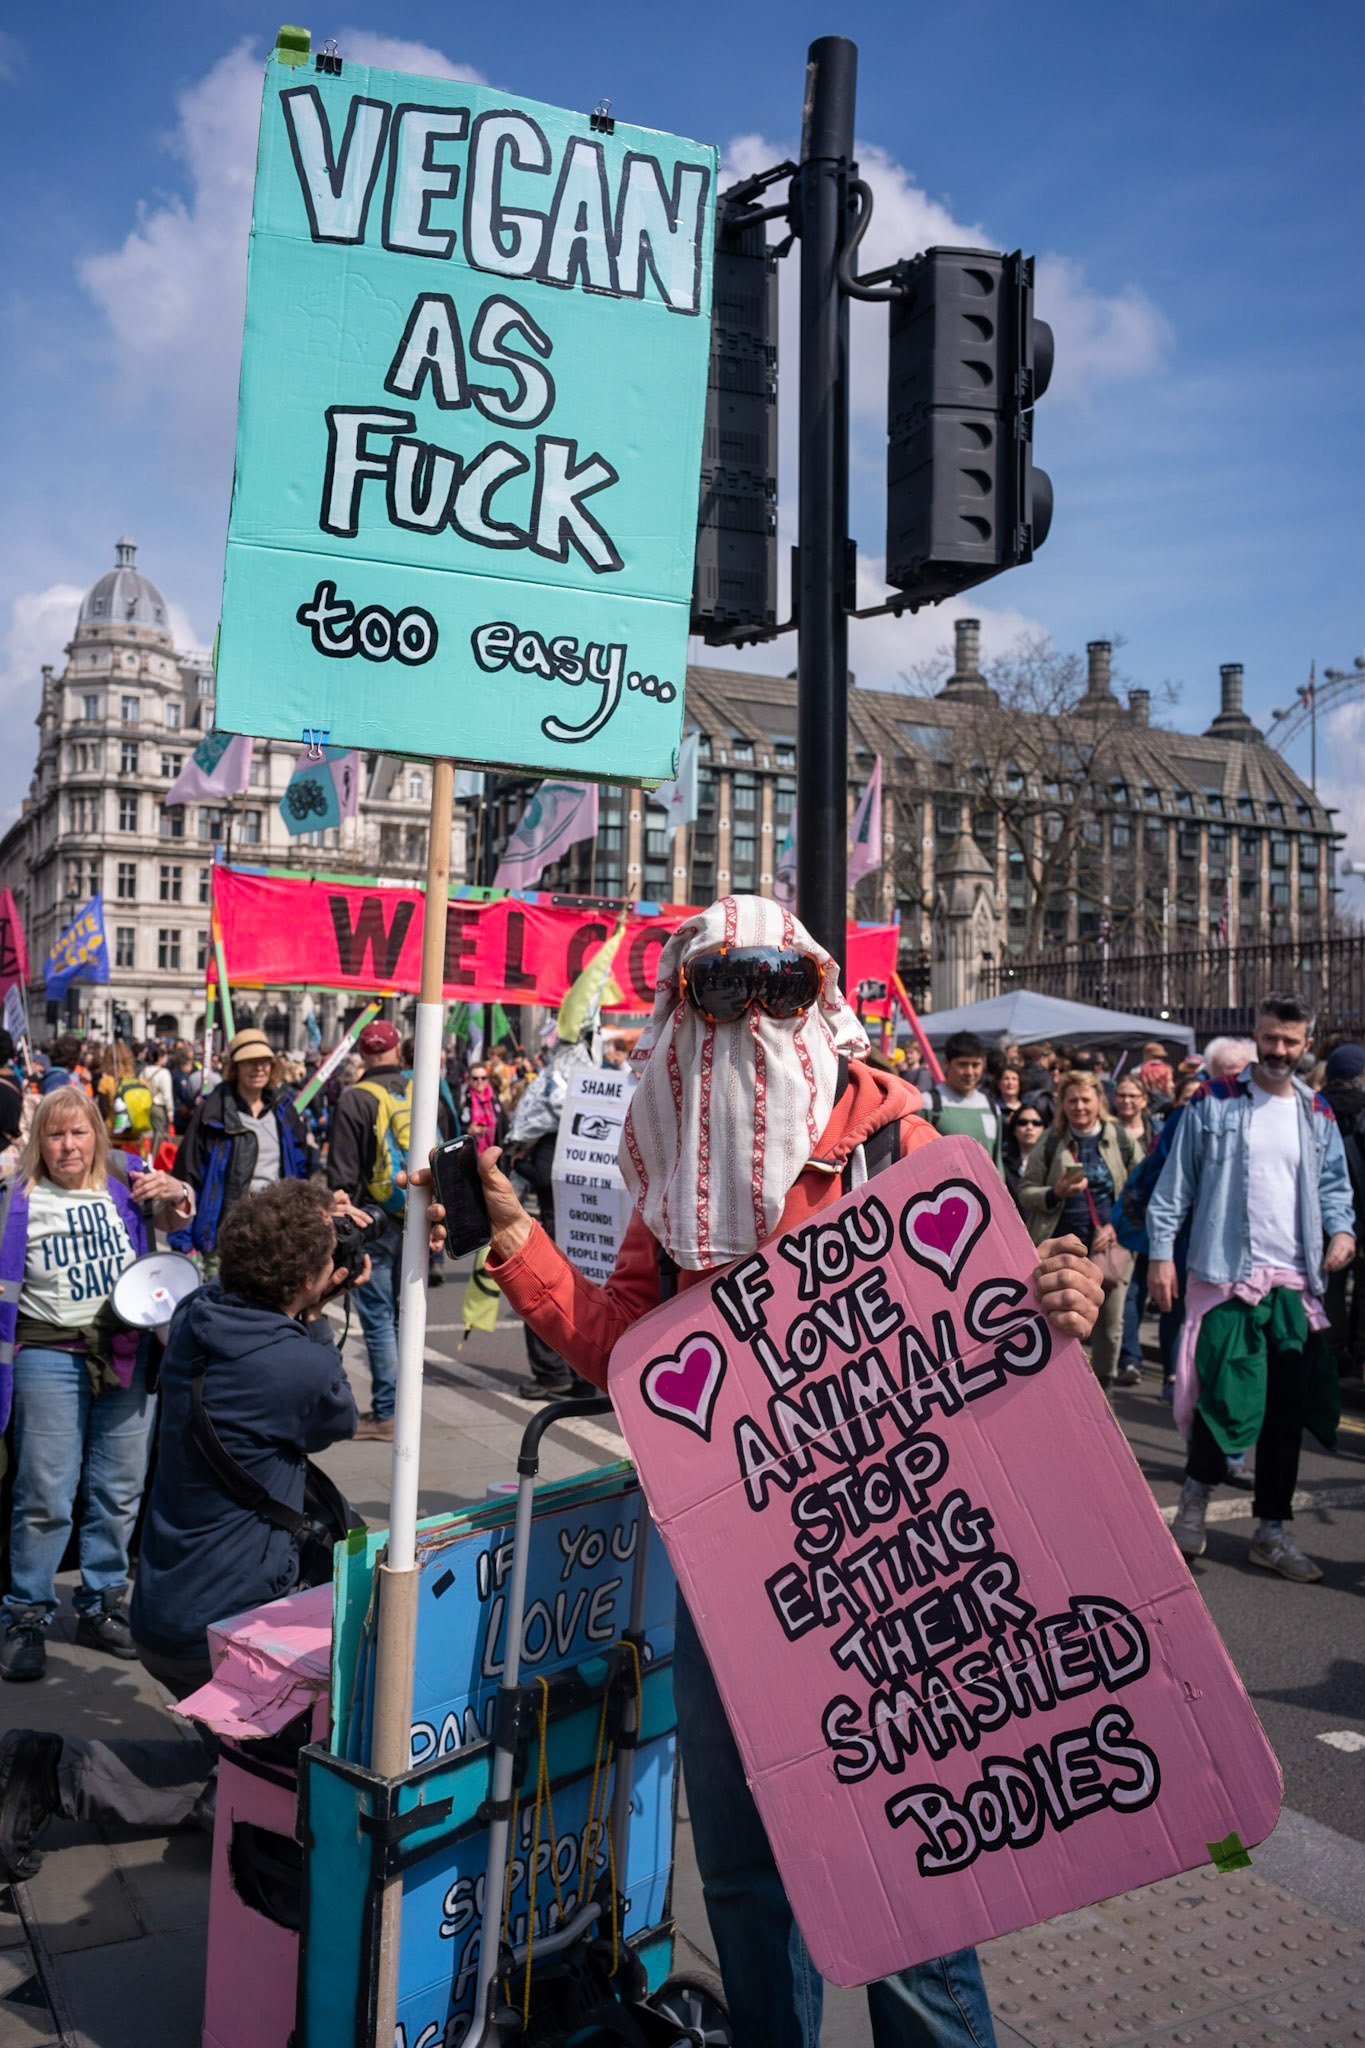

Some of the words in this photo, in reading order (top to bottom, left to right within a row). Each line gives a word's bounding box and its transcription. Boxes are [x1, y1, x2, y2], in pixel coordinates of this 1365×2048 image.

[280, 85, 711, 316] VEGAN
[385, 293, 555, 429] AS
[320, 405, 624, 574] FUCK
[297, 580, 437, 662] too
[472, 622, 677, 743] easy...
[581, 1079, 623, 1098] SHAME
[565, 1173, 587, 1186] KEEP
[590, 1176, 598, 1188] IT
[601, 1178, 612, 1190] IN
[566, 1148, 587, 1161] YOU
[569, 1209, 613, 1226] GROUND!
[581, 1193, 598, 1206] THE
[66, 1201, 110, 1236] FOR
[567, 1246, 598, 1261] PEOPLE
[570, 1230, 596, 1244] SERVE
[598, 1234, 615, 1247] THE
[711, 1253, 774, 1336] IF
[779, 1196, 895, 1297] YOU
[753, 1266, 905, 1392] LOVE
[734, 1276, 1054, 1512] ANIMALS
[558, 1519, 638, 1581] YOU
[791, 1432, 949, 1560] STOP
[481, 1576, 622, 1679] LOVE
[765, 1489, 995, 1642] EATING
[831, 1552, 1037, 1688] THEIR
[821, 1596, 1152, 1784] SMASHED
[885, 1706, 1161, 1877] BODIES
